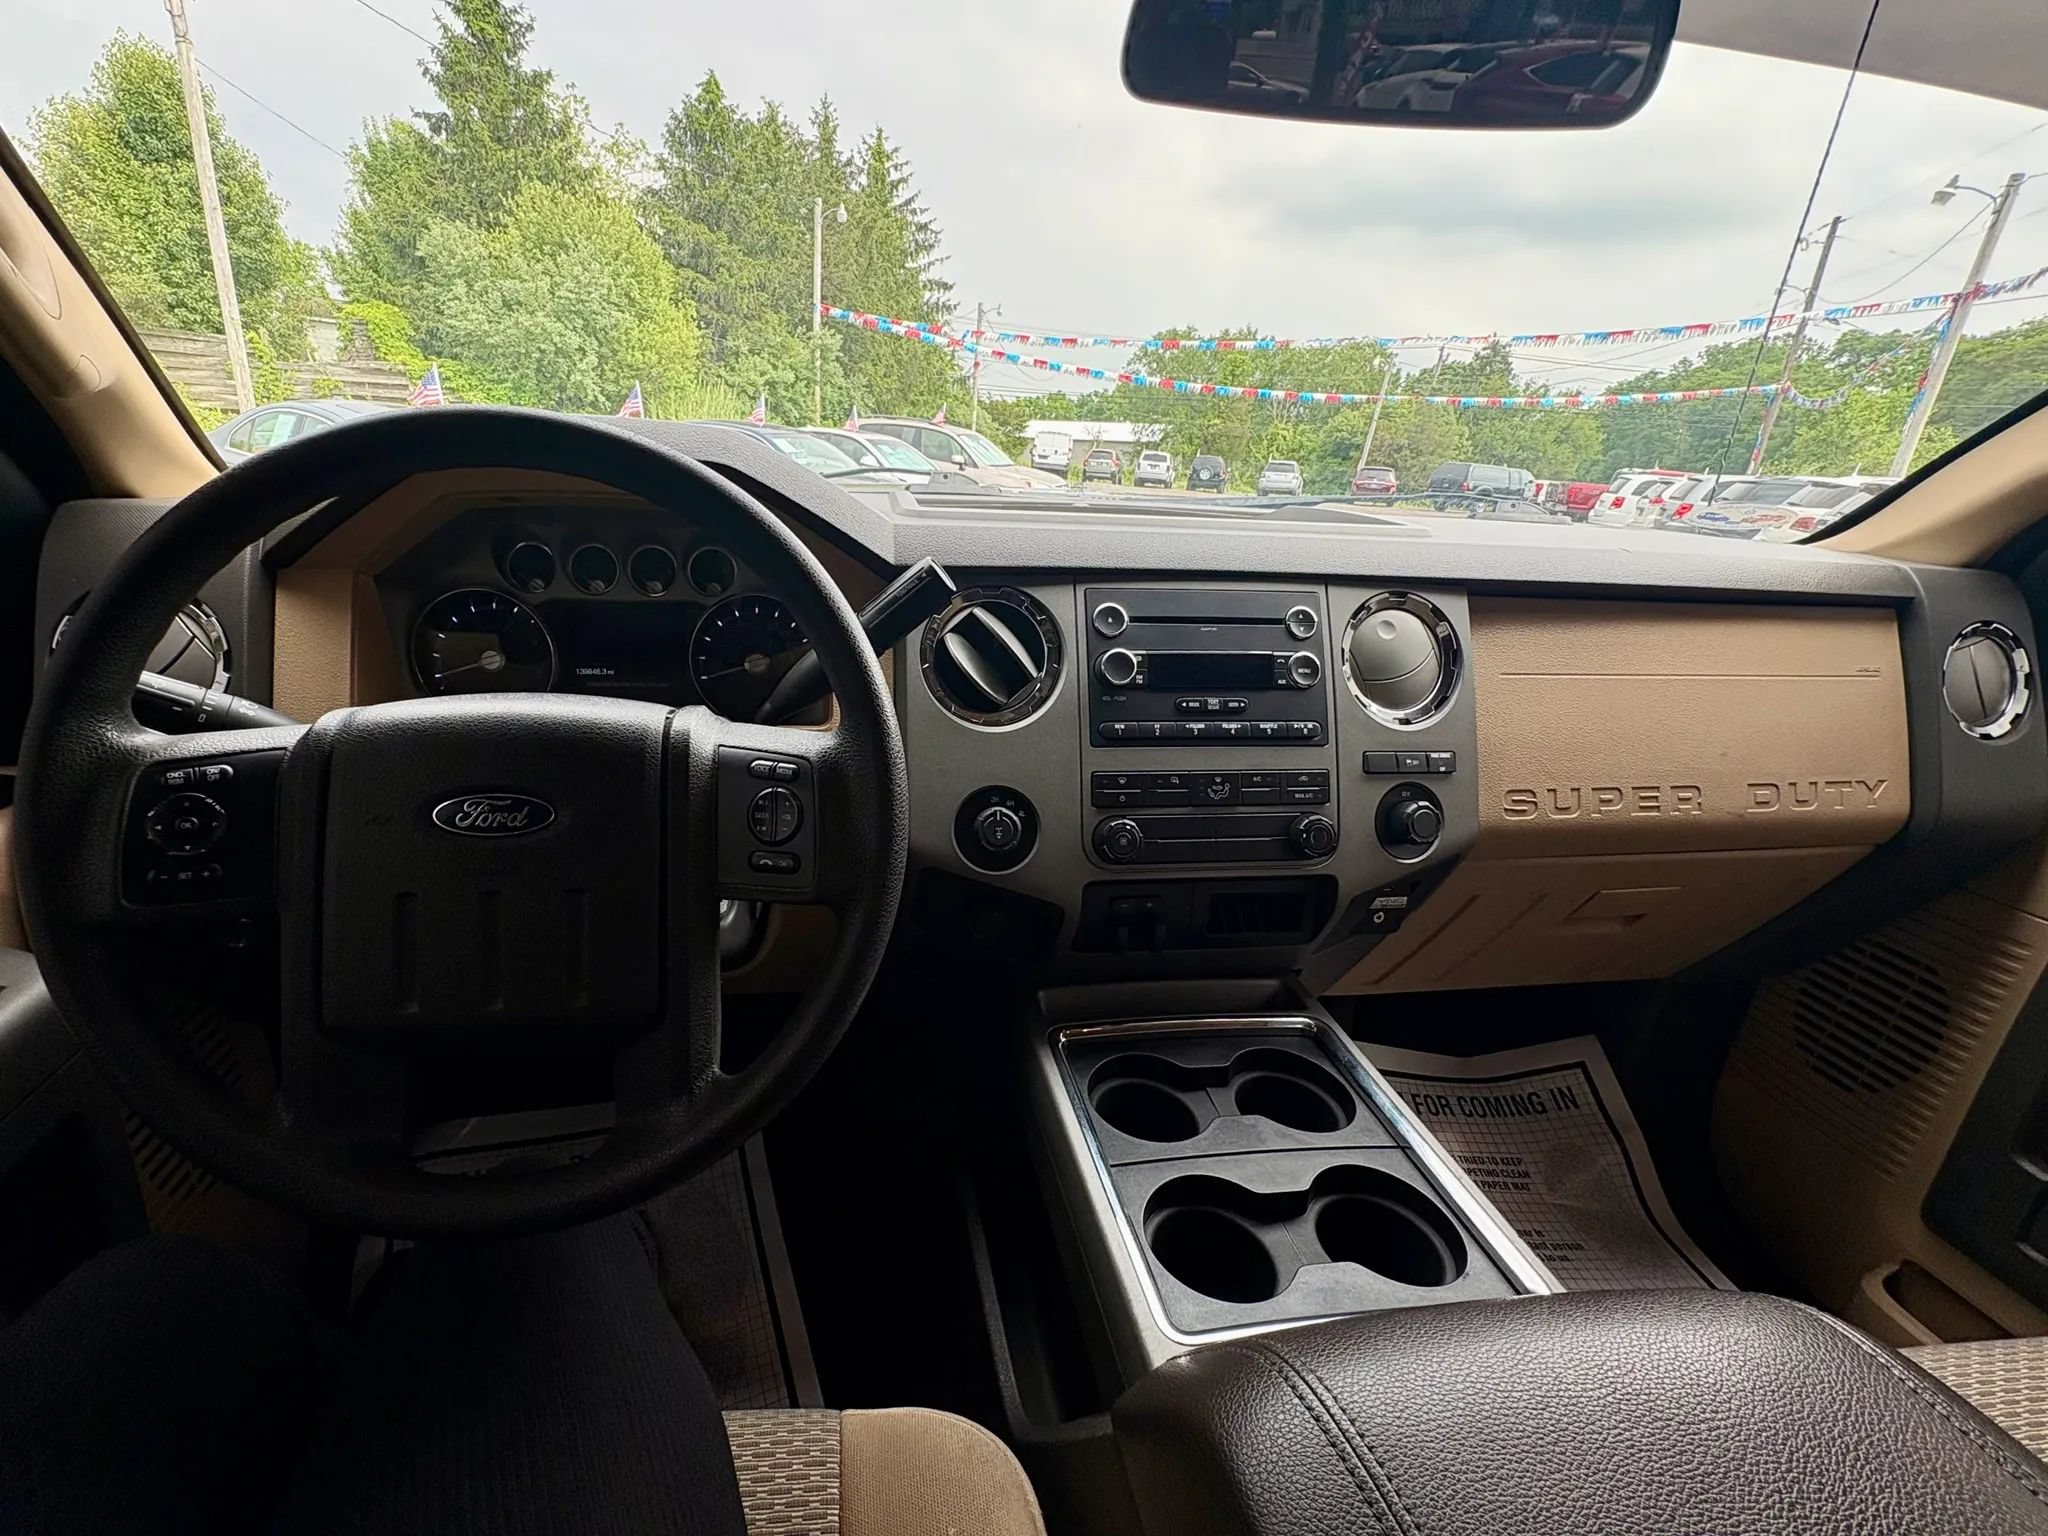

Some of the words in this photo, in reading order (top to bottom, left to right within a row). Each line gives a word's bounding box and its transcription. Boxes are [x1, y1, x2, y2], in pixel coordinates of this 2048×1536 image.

[1503, 785, 1703, 820] SUPER
[1745, 779, 1889, 813] DUTY
[455, 798, 530, 828] Ford
[180, 822, 192, 830] OK
[1411, 1093, 1456, 1117] FOR
[1457, 1091, 1548, 1118] COMING
[1550, 1086, 1580, 1112] IN
[1457, 1155, 1486, 1165] TRIED
[1485, 1156, 1499, 1166] TO
[1499, 1157, 1522, 1167] KEEP
[1500, 1169, 1532, 1179] CLEAN
[1480, 1180, 1511, 1191] PAPER
[1511, 1182, 1531, 1192] MAT
[1548, 1242, 1586, 1252] person
